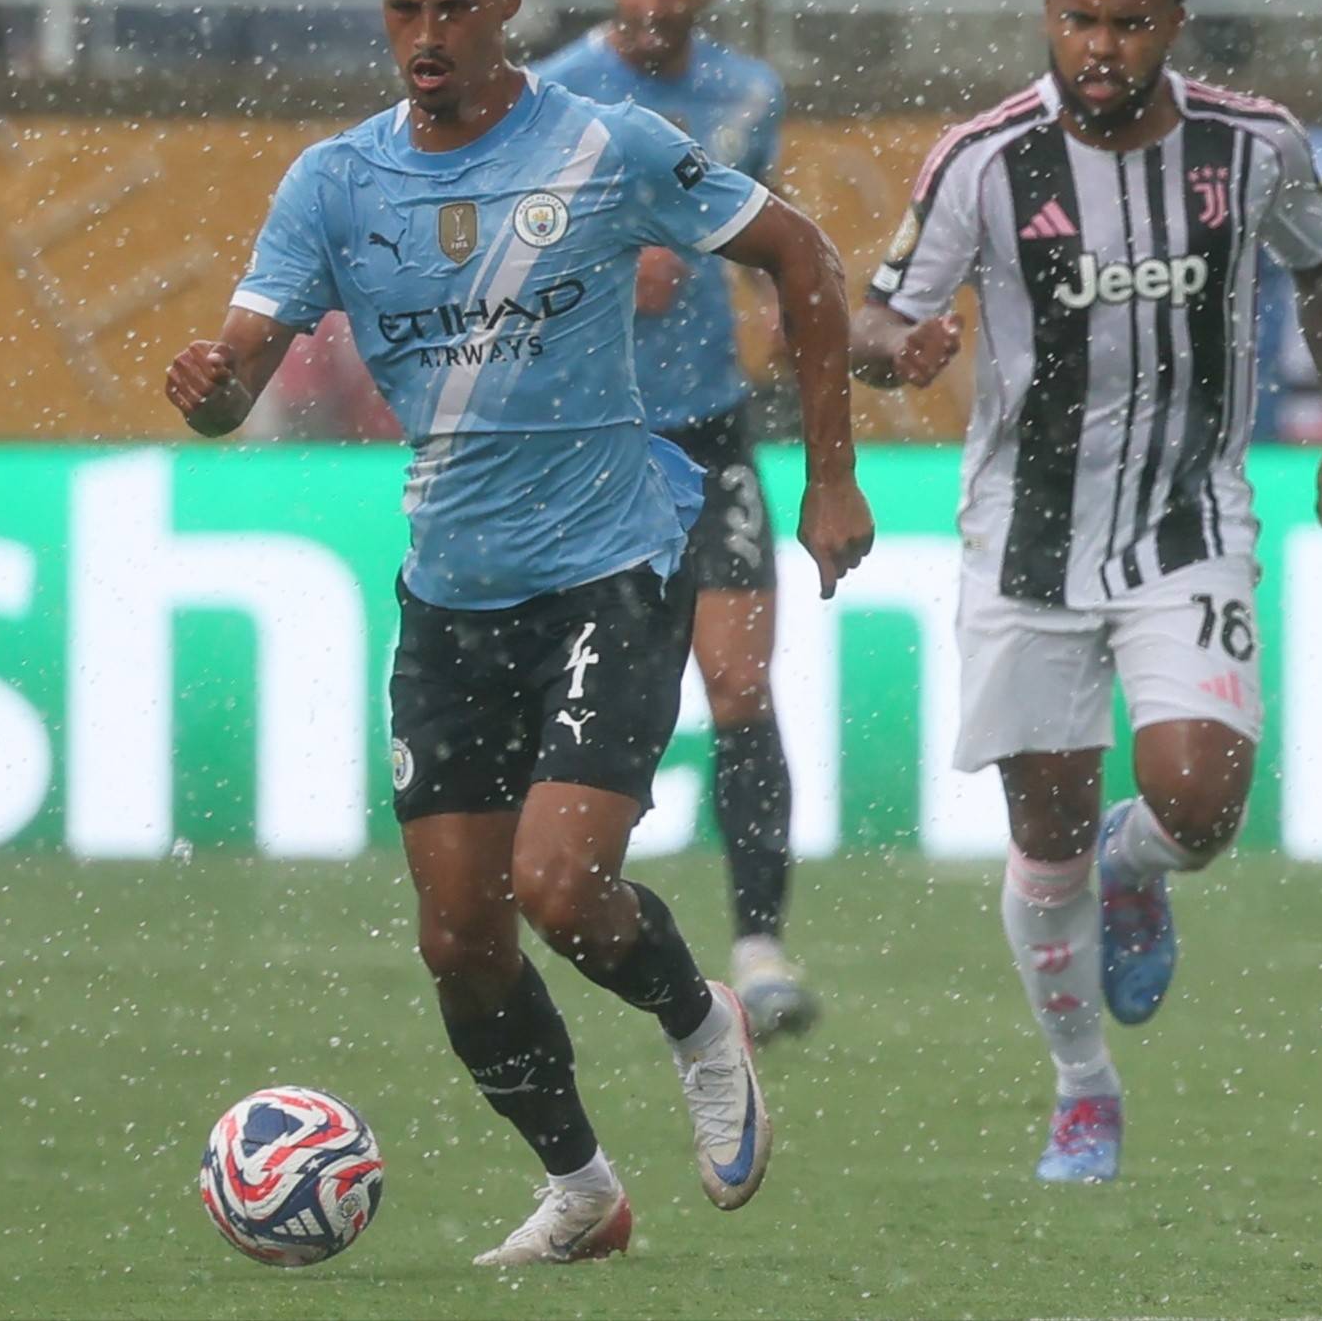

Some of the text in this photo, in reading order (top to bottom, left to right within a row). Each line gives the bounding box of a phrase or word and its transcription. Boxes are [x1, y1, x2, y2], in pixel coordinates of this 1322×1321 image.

[379, 278, 586, 344] ETIHAD
[1054, 253, 1209, 310] Jeep
[419, 335, 544, 368] AIRWAYS
[563, 621, 599, 699] 4
